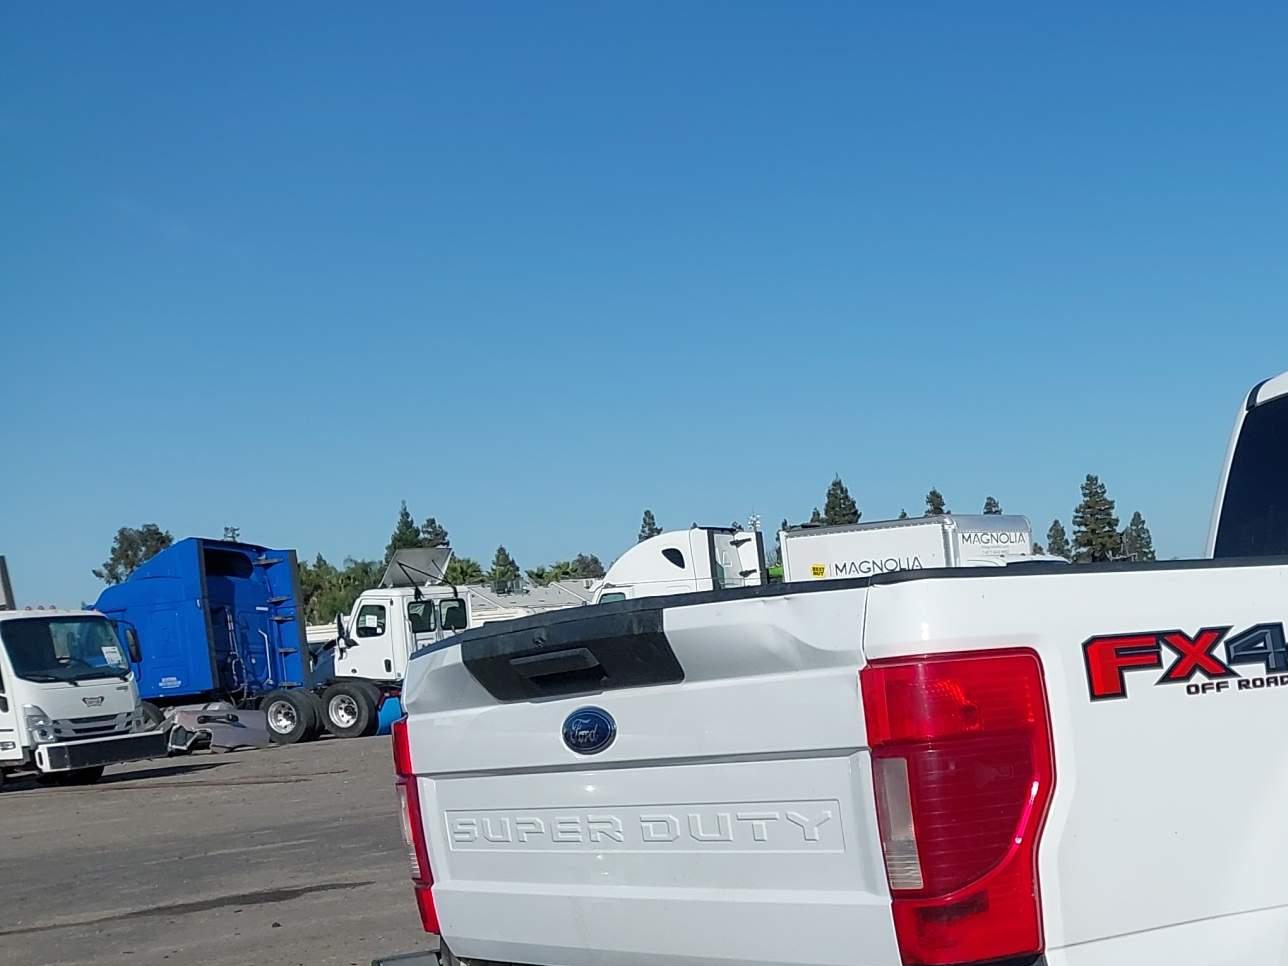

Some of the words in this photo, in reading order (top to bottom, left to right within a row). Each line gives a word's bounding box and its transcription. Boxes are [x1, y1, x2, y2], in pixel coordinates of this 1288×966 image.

[961, 532, 1026, 545] MAGNOLIA
[834, 556, 923, 576] MAGNOLIA
[1186, 680, 1230, 696] OFF
[570, 718, 599, 744] Ford
[452, 814, 625, 843] SUPER
[639, 809, 833, 843] DUTY
